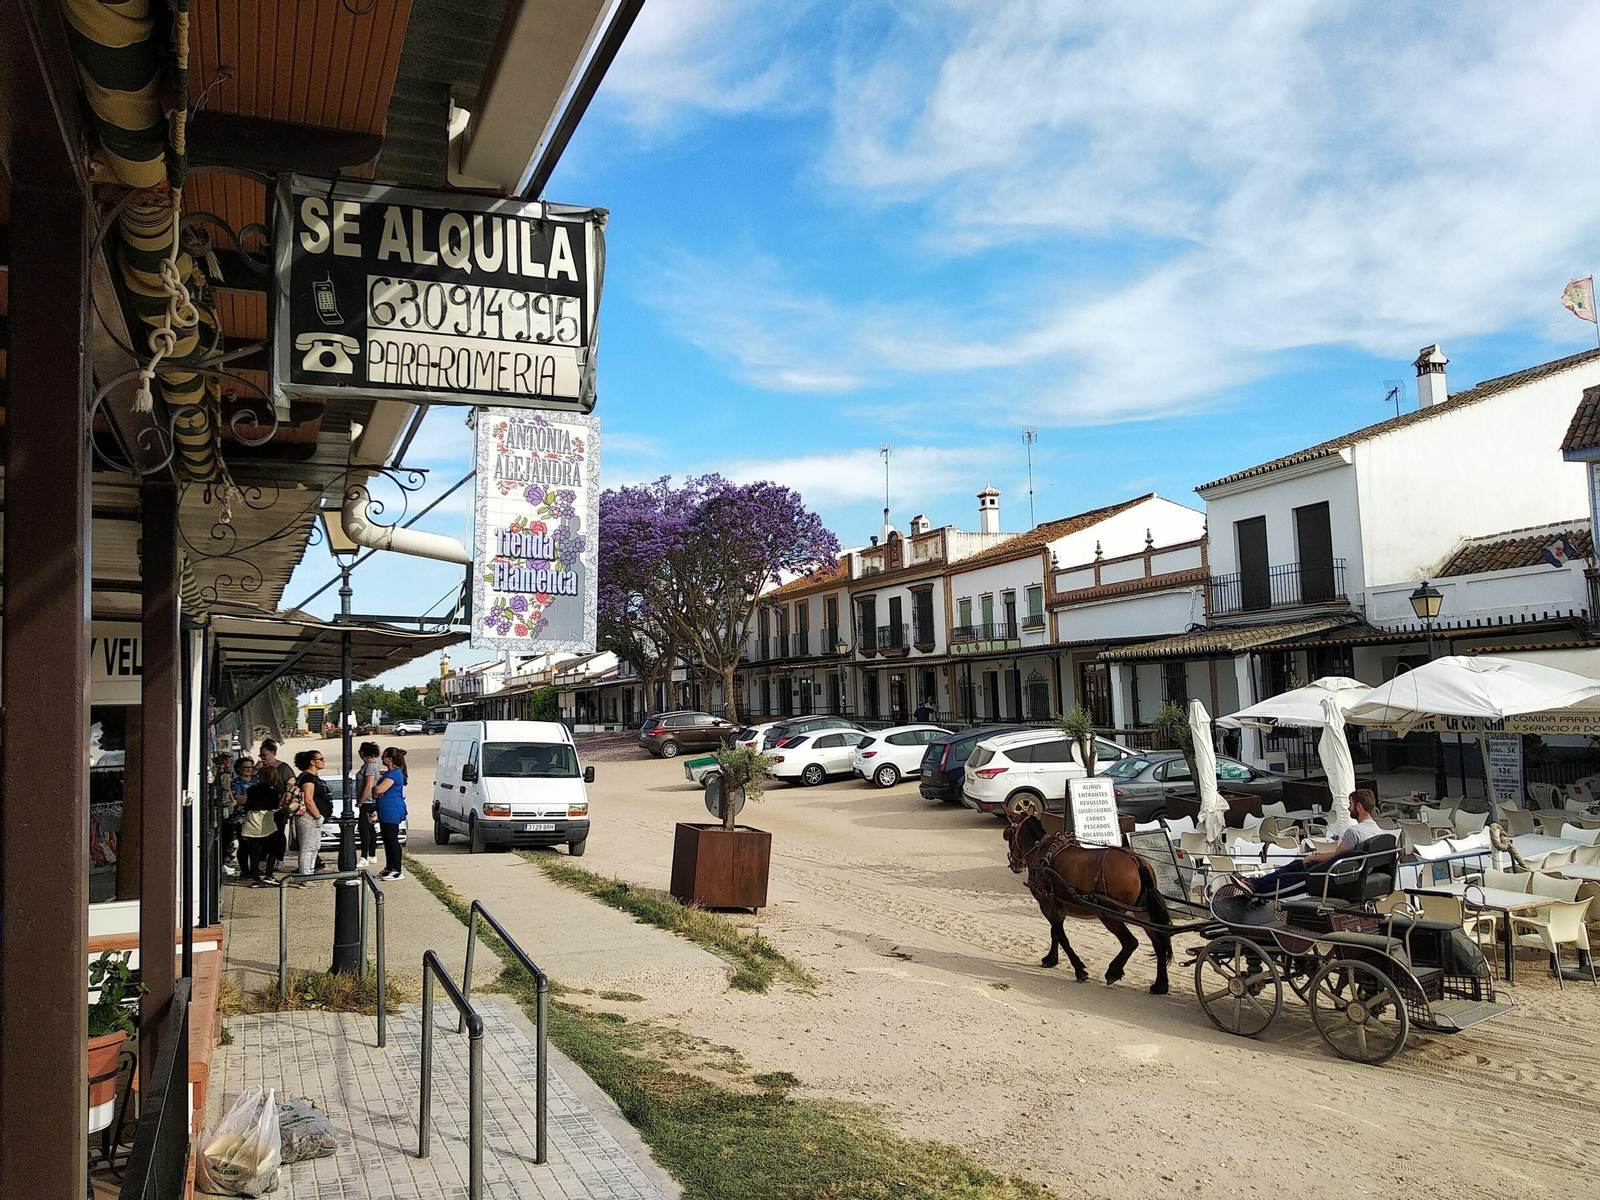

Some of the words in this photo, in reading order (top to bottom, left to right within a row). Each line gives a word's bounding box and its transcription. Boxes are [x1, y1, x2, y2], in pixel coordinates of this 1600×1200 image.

[299, 197, 362, 258] SE
[377, 205, 579, 283] ALQUILA
[368, 276, 579, 344] 630914995
[504, 422, 573, 456] ANTONIA
[493, 453, 582, 487] ALEJANDRA
[494, 527, 556, 562] Tienda
[492, 561, 579, 596] Flamenca
[1513, 715, 1556, 723] COMIDA
[1560, 716, 1590, 724] PARA
[1513, 724, 1520, 732] Y
[1572, 725, 1581, 733] A
[1498, 767, 1511, 775] 12€
